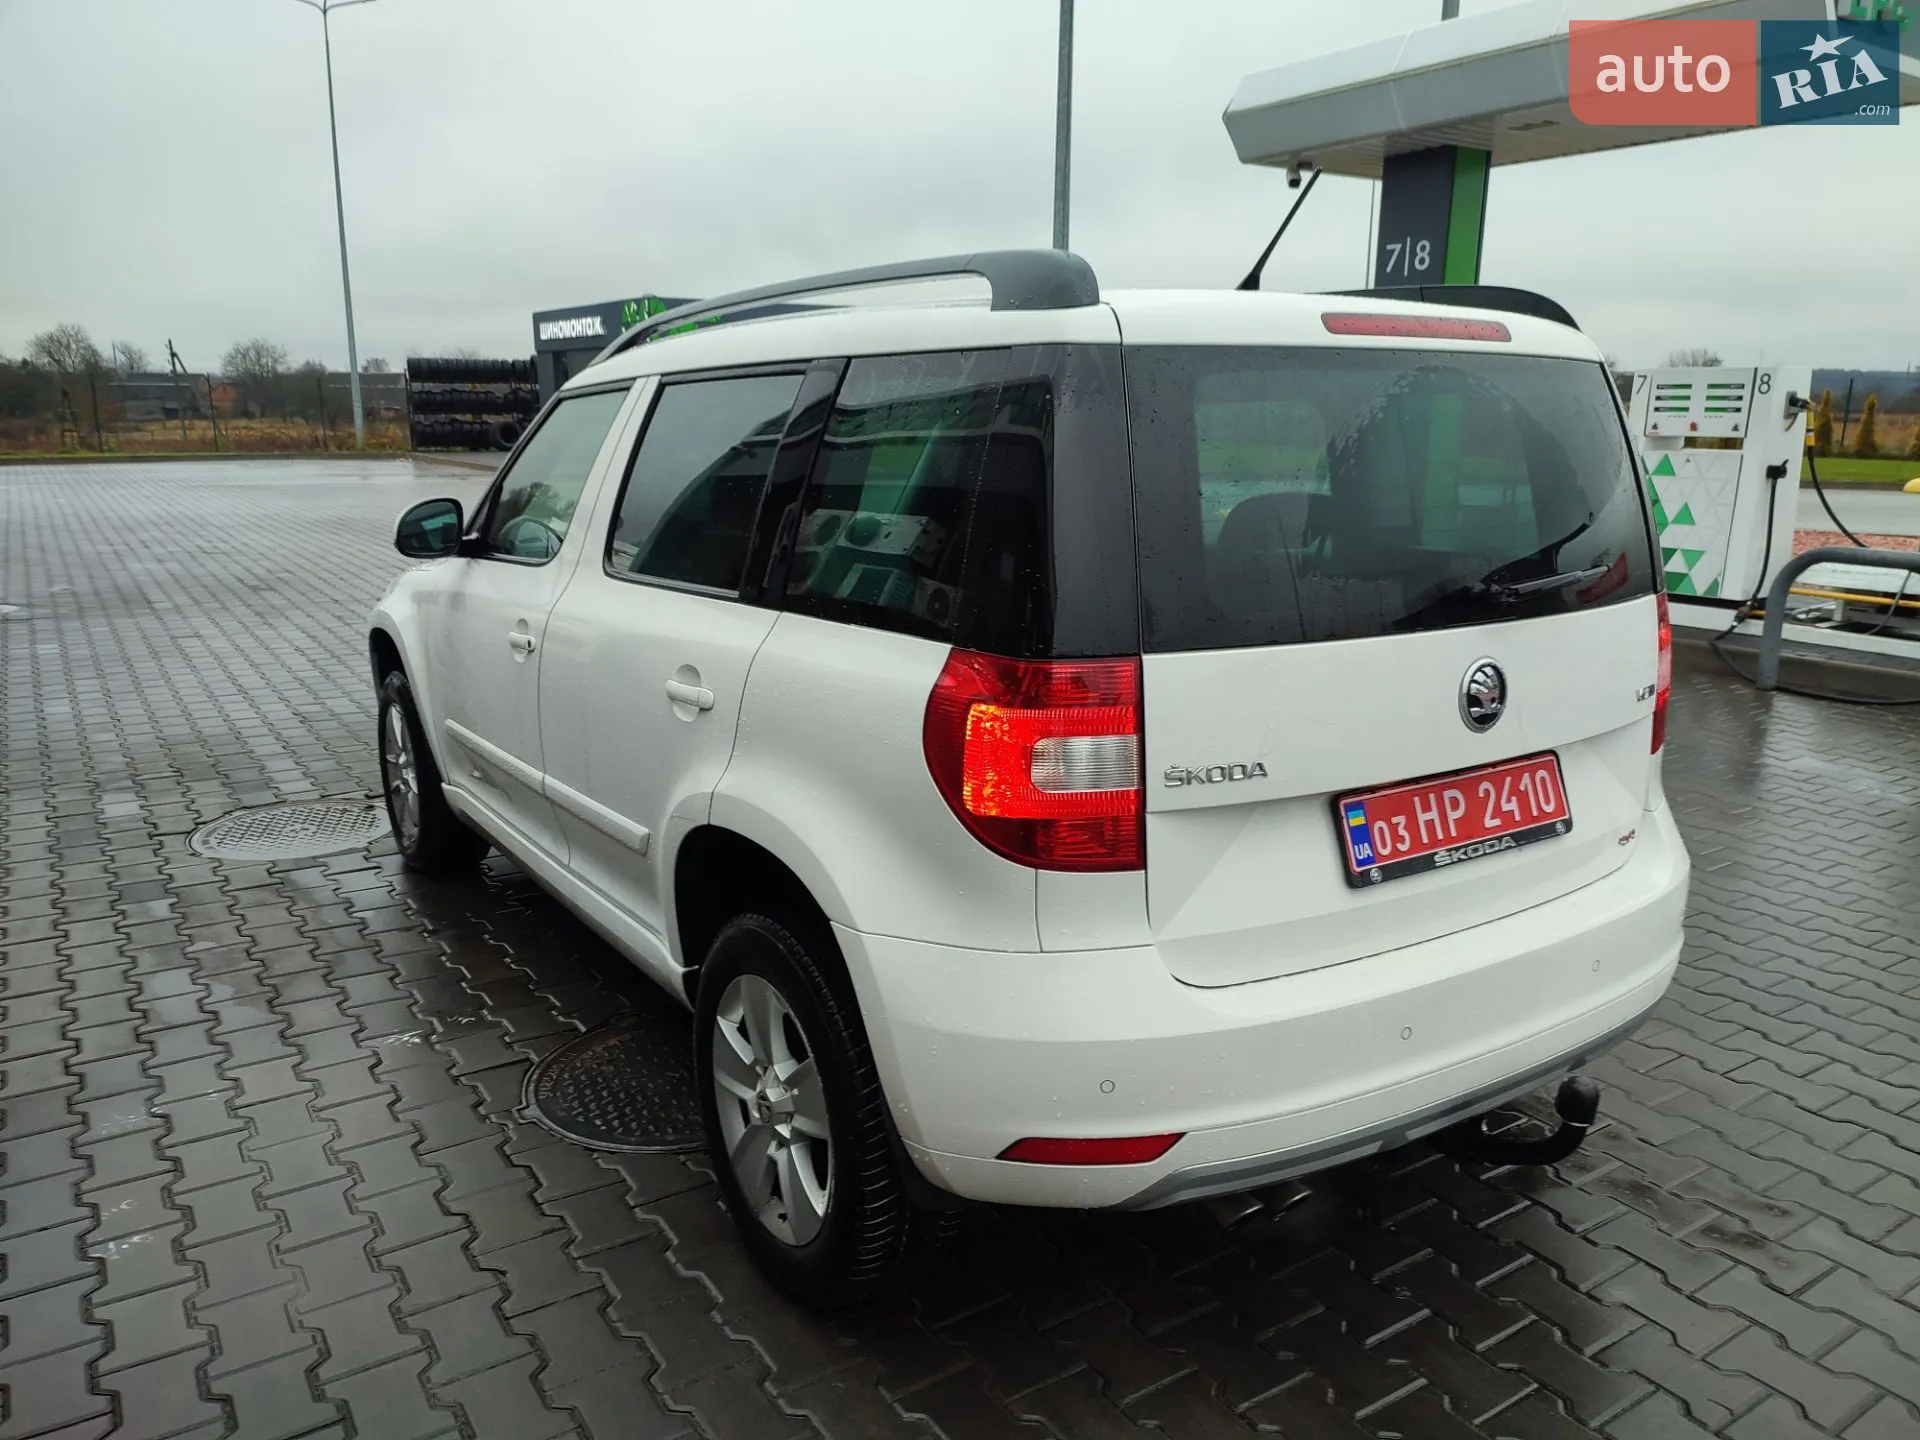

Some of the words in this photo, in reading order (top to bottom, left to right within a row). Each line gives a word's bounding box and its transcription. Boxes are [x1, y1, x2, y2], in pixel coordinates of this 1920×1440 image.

[1636, 374, 1648, 395] 7
[1757, 372, 1772, 395] 8
[1164, 760, 1268, 788] ŠKODA
[1373, 815, 1411, 856] 03
[1413, 788, 1466, 844] HP
[1477, 769, 1556, 829] 2410
[1354, 843, 1373, 860] UA
[1433, 836, 1518, 867] ŠKODA
